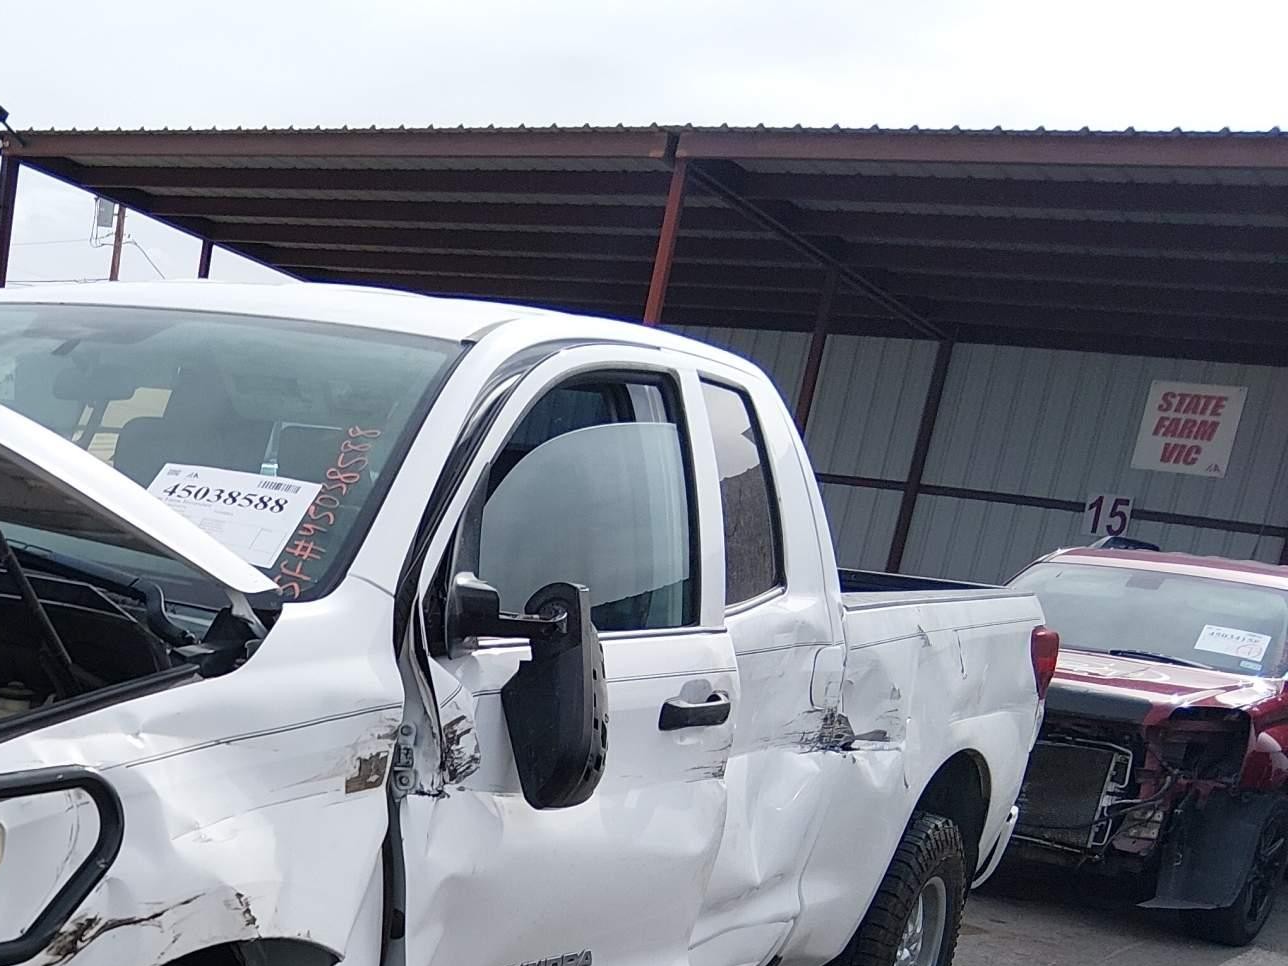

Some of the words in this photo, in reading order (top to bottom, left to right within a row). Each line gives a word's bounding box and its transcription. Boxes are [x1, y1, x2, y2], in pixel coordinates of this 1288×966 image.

[1158, 392, 1228, 416] STATE
[1152, 416, 1220, 442] FARM
[1160, 443, 1202, 466] VIC
[163, 483, 288, 513] 45038588
[1088, 496, 1130, 536] 15
